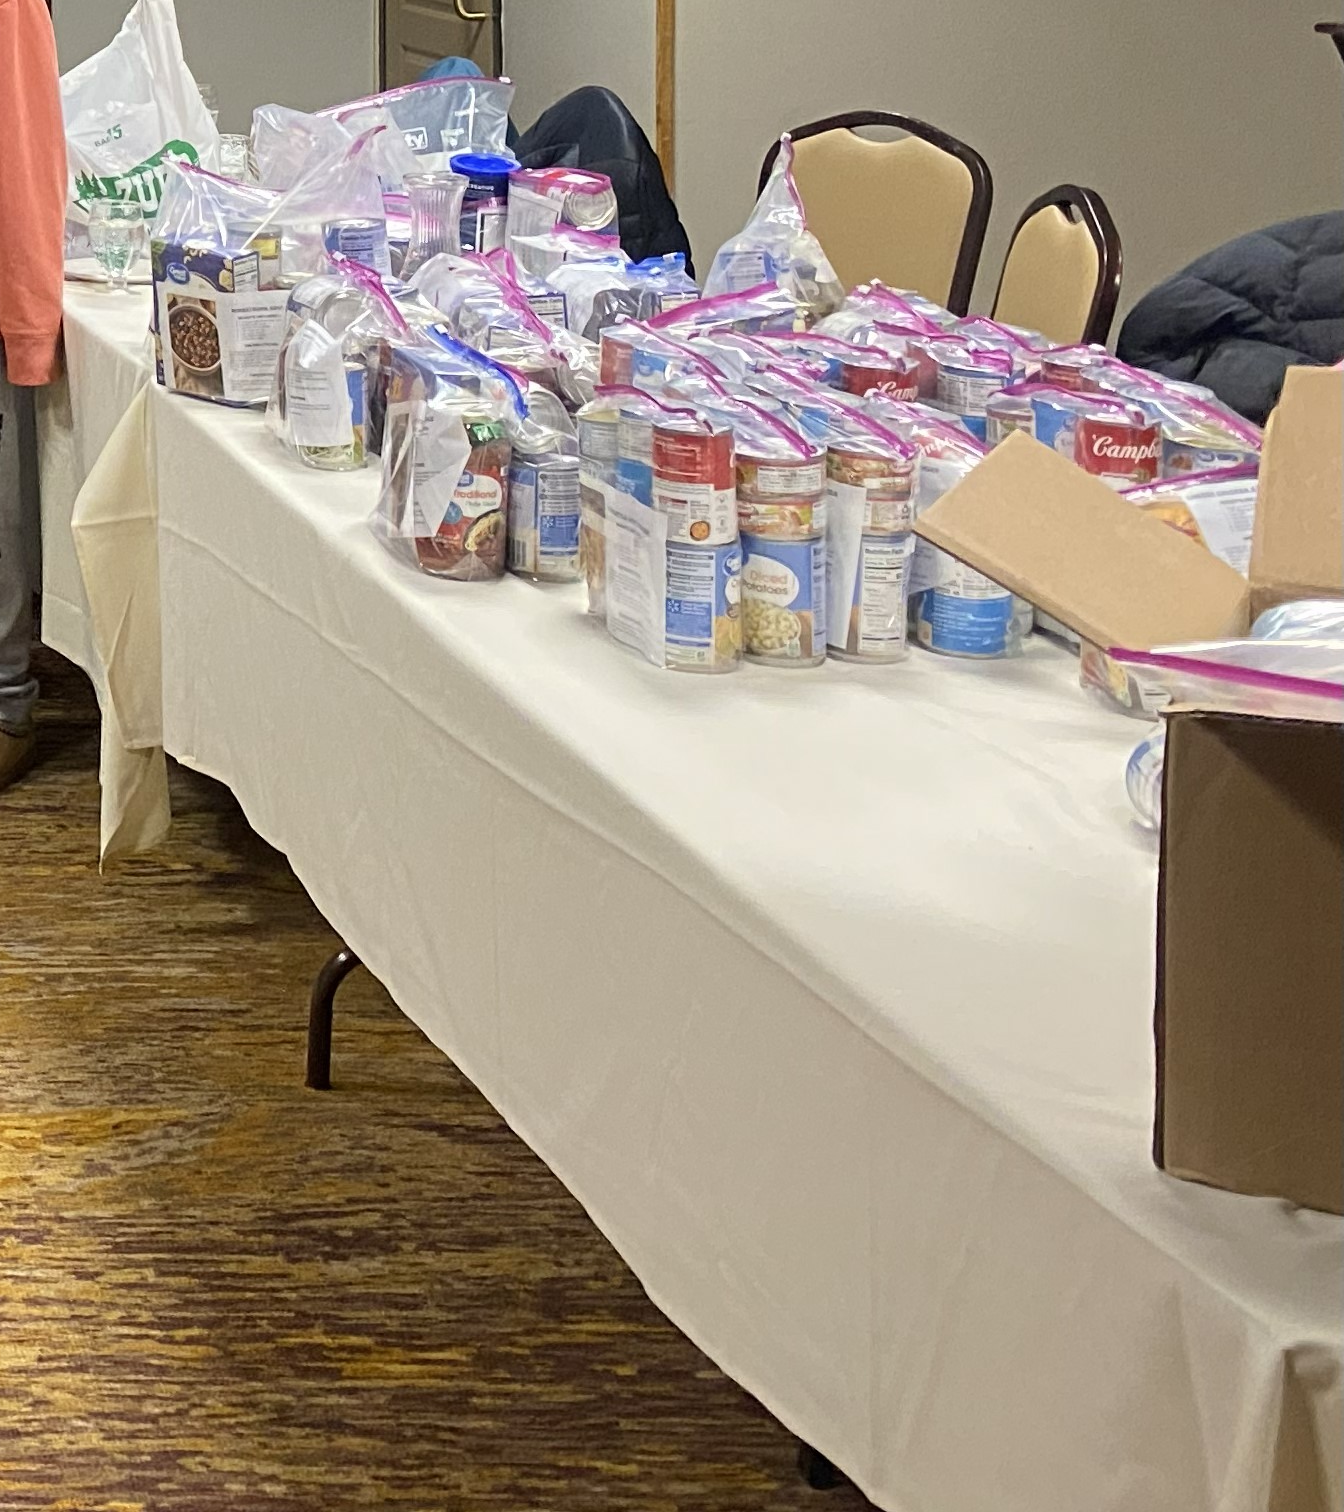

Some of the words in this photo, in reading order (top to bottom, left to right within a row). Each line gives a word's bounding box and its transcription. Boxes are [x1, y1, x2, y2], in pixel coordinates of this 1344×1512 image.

[106, 123, 123, 140] 15
[1093, 433, 1162, 464] Campb
[749, 568, 788, 586] Diced
